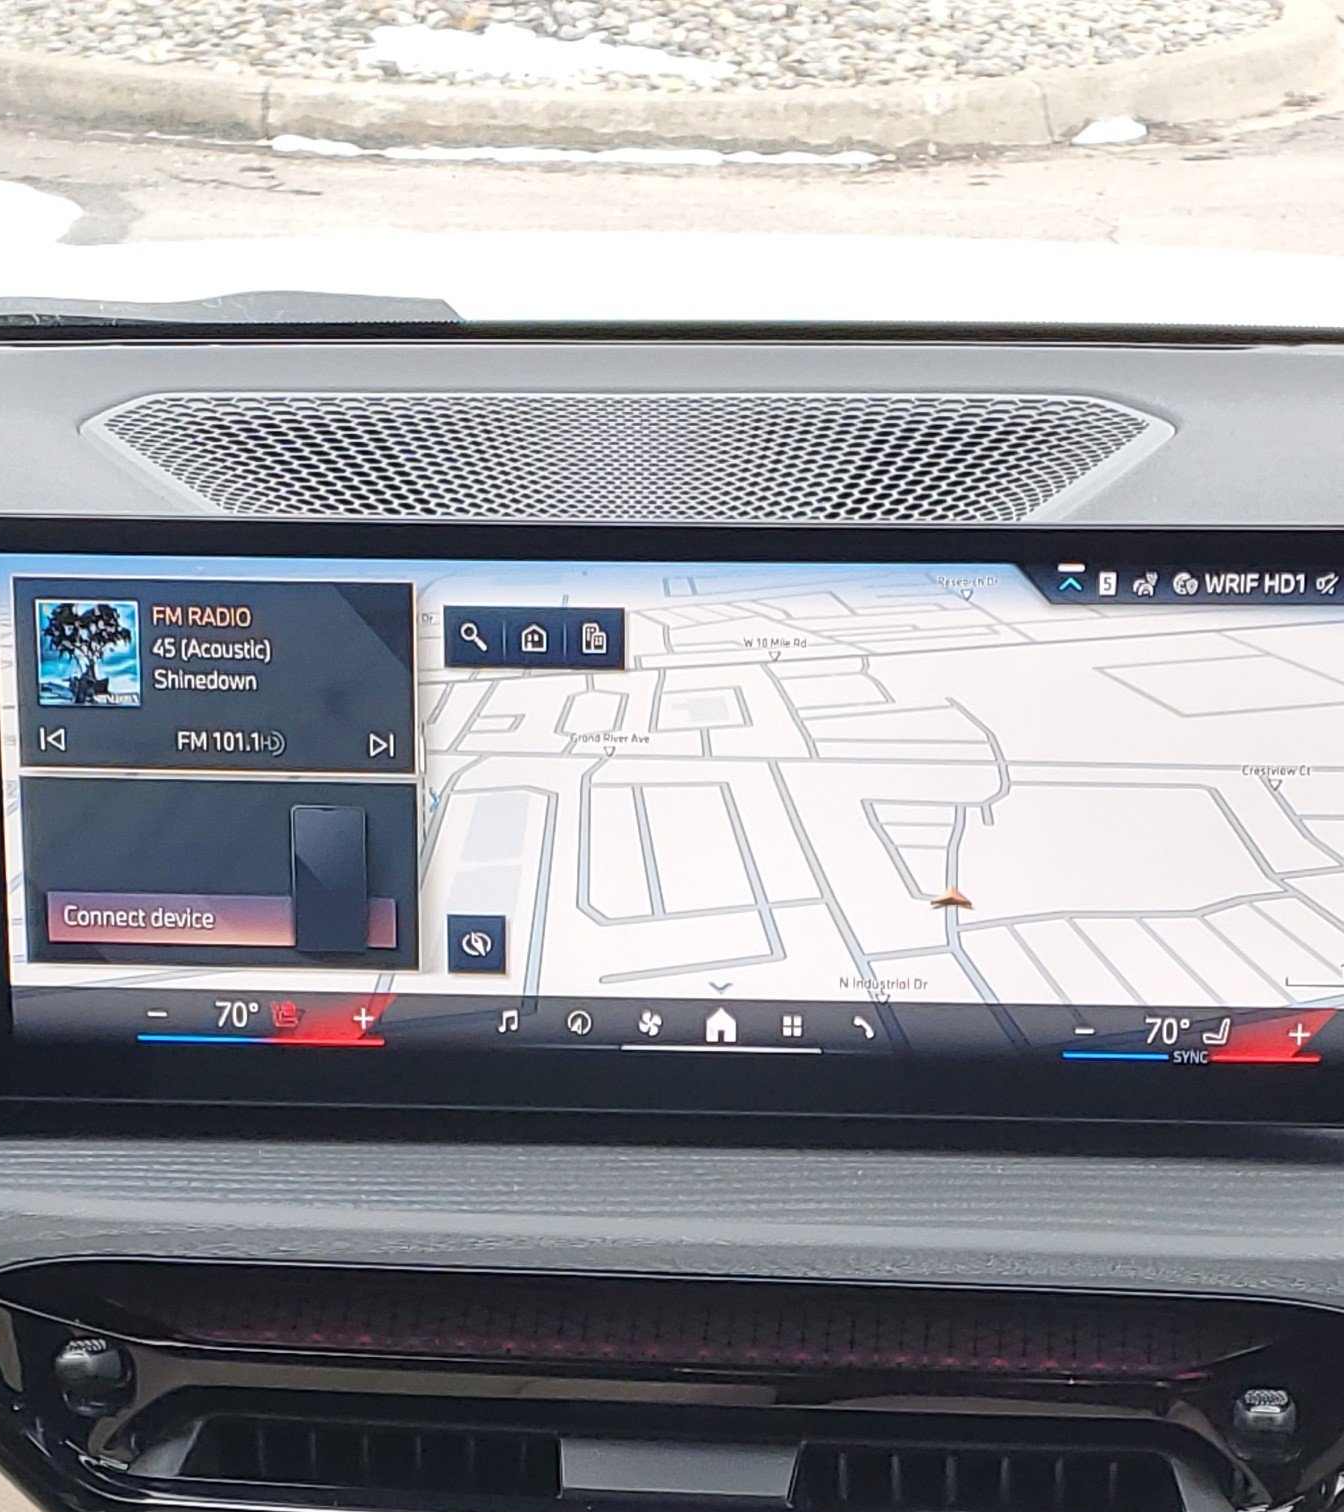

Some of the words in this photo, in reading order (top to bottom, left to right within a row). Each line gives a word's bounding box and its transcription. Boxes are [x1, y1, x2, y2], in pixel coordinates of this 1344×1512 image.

[1205, 574, 1259, 594] WRIF
[1265, 575, 1306, 594] HD1
[153, 606, 182, 626] FM
[188, 607, 252, 628] RADIO
[153, 638, 176, 658] 45
[181, 638, 271, 662] (Acoustic)
[744, 638, 753, 647] W
[757, 638, 767, 648] 10
[771, 638, 790, 648] Mile
[793, 638, 807, 648] Rd
[153, 670, 258, 692] Shinedown
[177, 731, 208, 752] FM
[570, 733, 600, 743] Grand
[603, 733, 628, 743] River
[631, 733, 650, 743] Ave
[1242, 765, 1296, 776] Crestview
[64, 905, 146, 929] Connect
[150, 907, 215, 929] device
[839, 977, 849, 989] N
[853, 977, 910, 990] Industrial
[914, 978, 928, 990] Dr
[215, 1001, 259, 1028] 70°
[1145, 1018, 1191, 1045] 70°
[1172, 1050, 1210, 1066] SYNC
